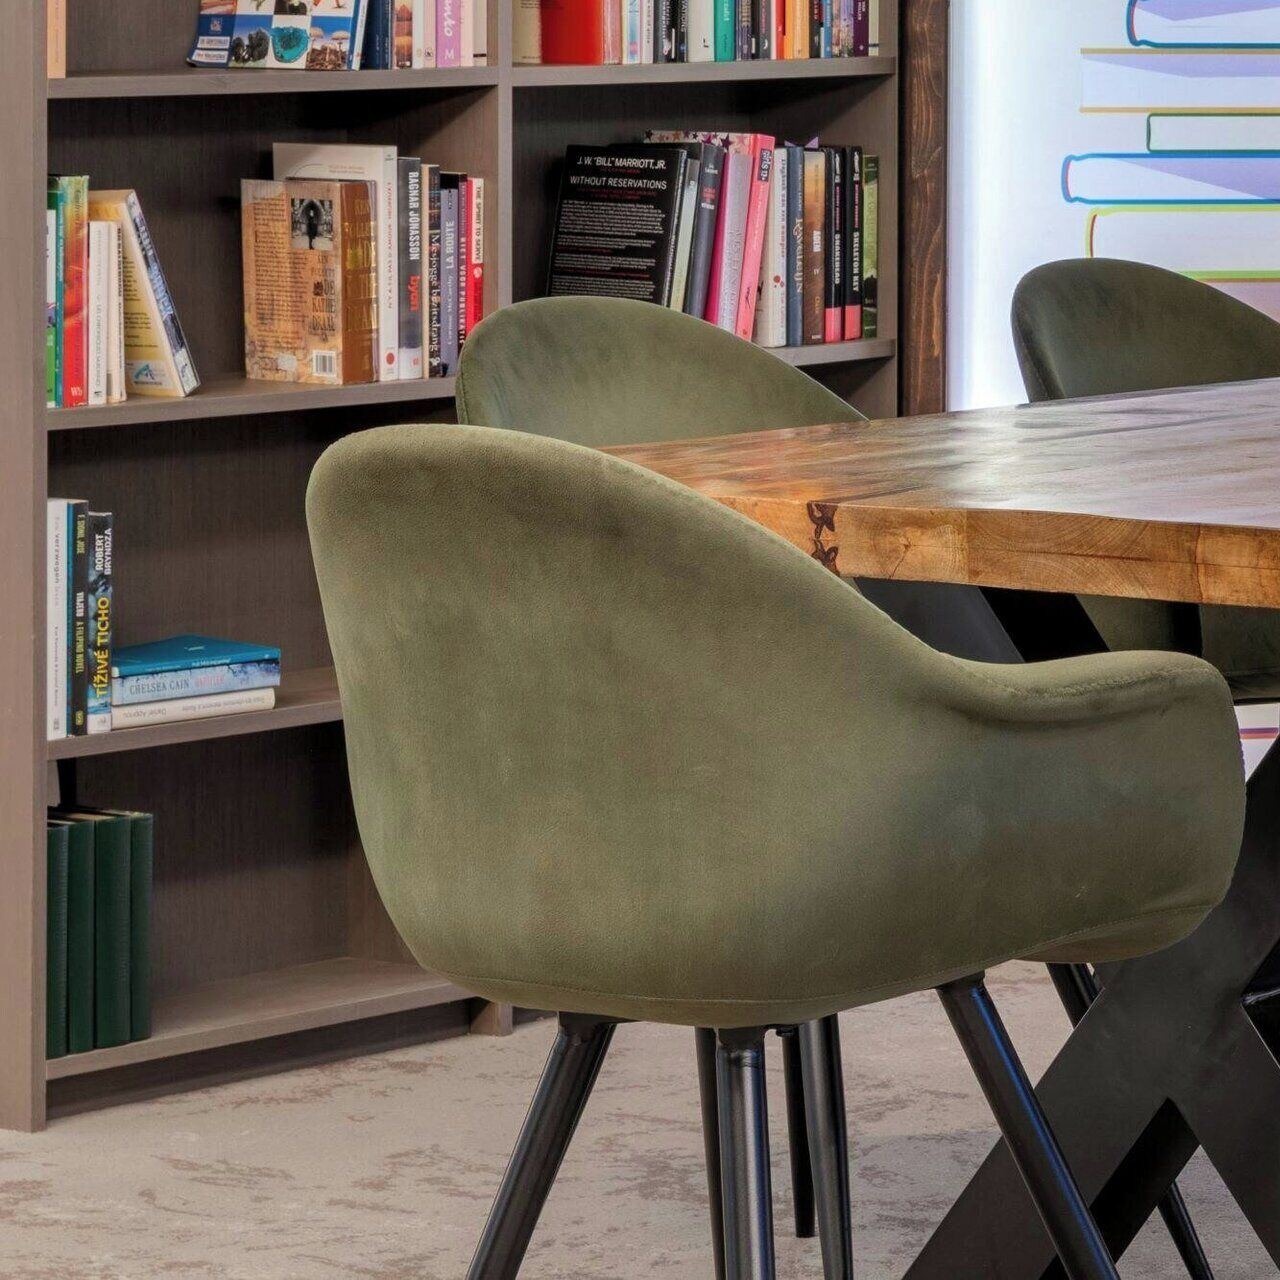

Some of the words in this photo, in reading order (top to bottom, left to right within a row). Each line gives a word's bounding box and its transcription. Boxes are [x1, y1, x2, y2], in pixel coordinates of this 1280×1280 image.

[570, 175, 607, 188] WITHOUT
[607, 177, 668, 191] RESERVATIONS
[833, 232, 842, 286] SNAKEHEAD
[852, 231, 861, 275] SKELETON
[852, 276, 861, 293] KEY
[95, 533, 104, 572] ROBERT
[104, 527, 113, 576] BRYNDZA
[97, 596, 110, 646] TICHO
[91, 651, 109, 699] TÍŽIVÉ
[129, 680, 168, 696] CHELSEA
[169, 677, 190, 691] CAIN
